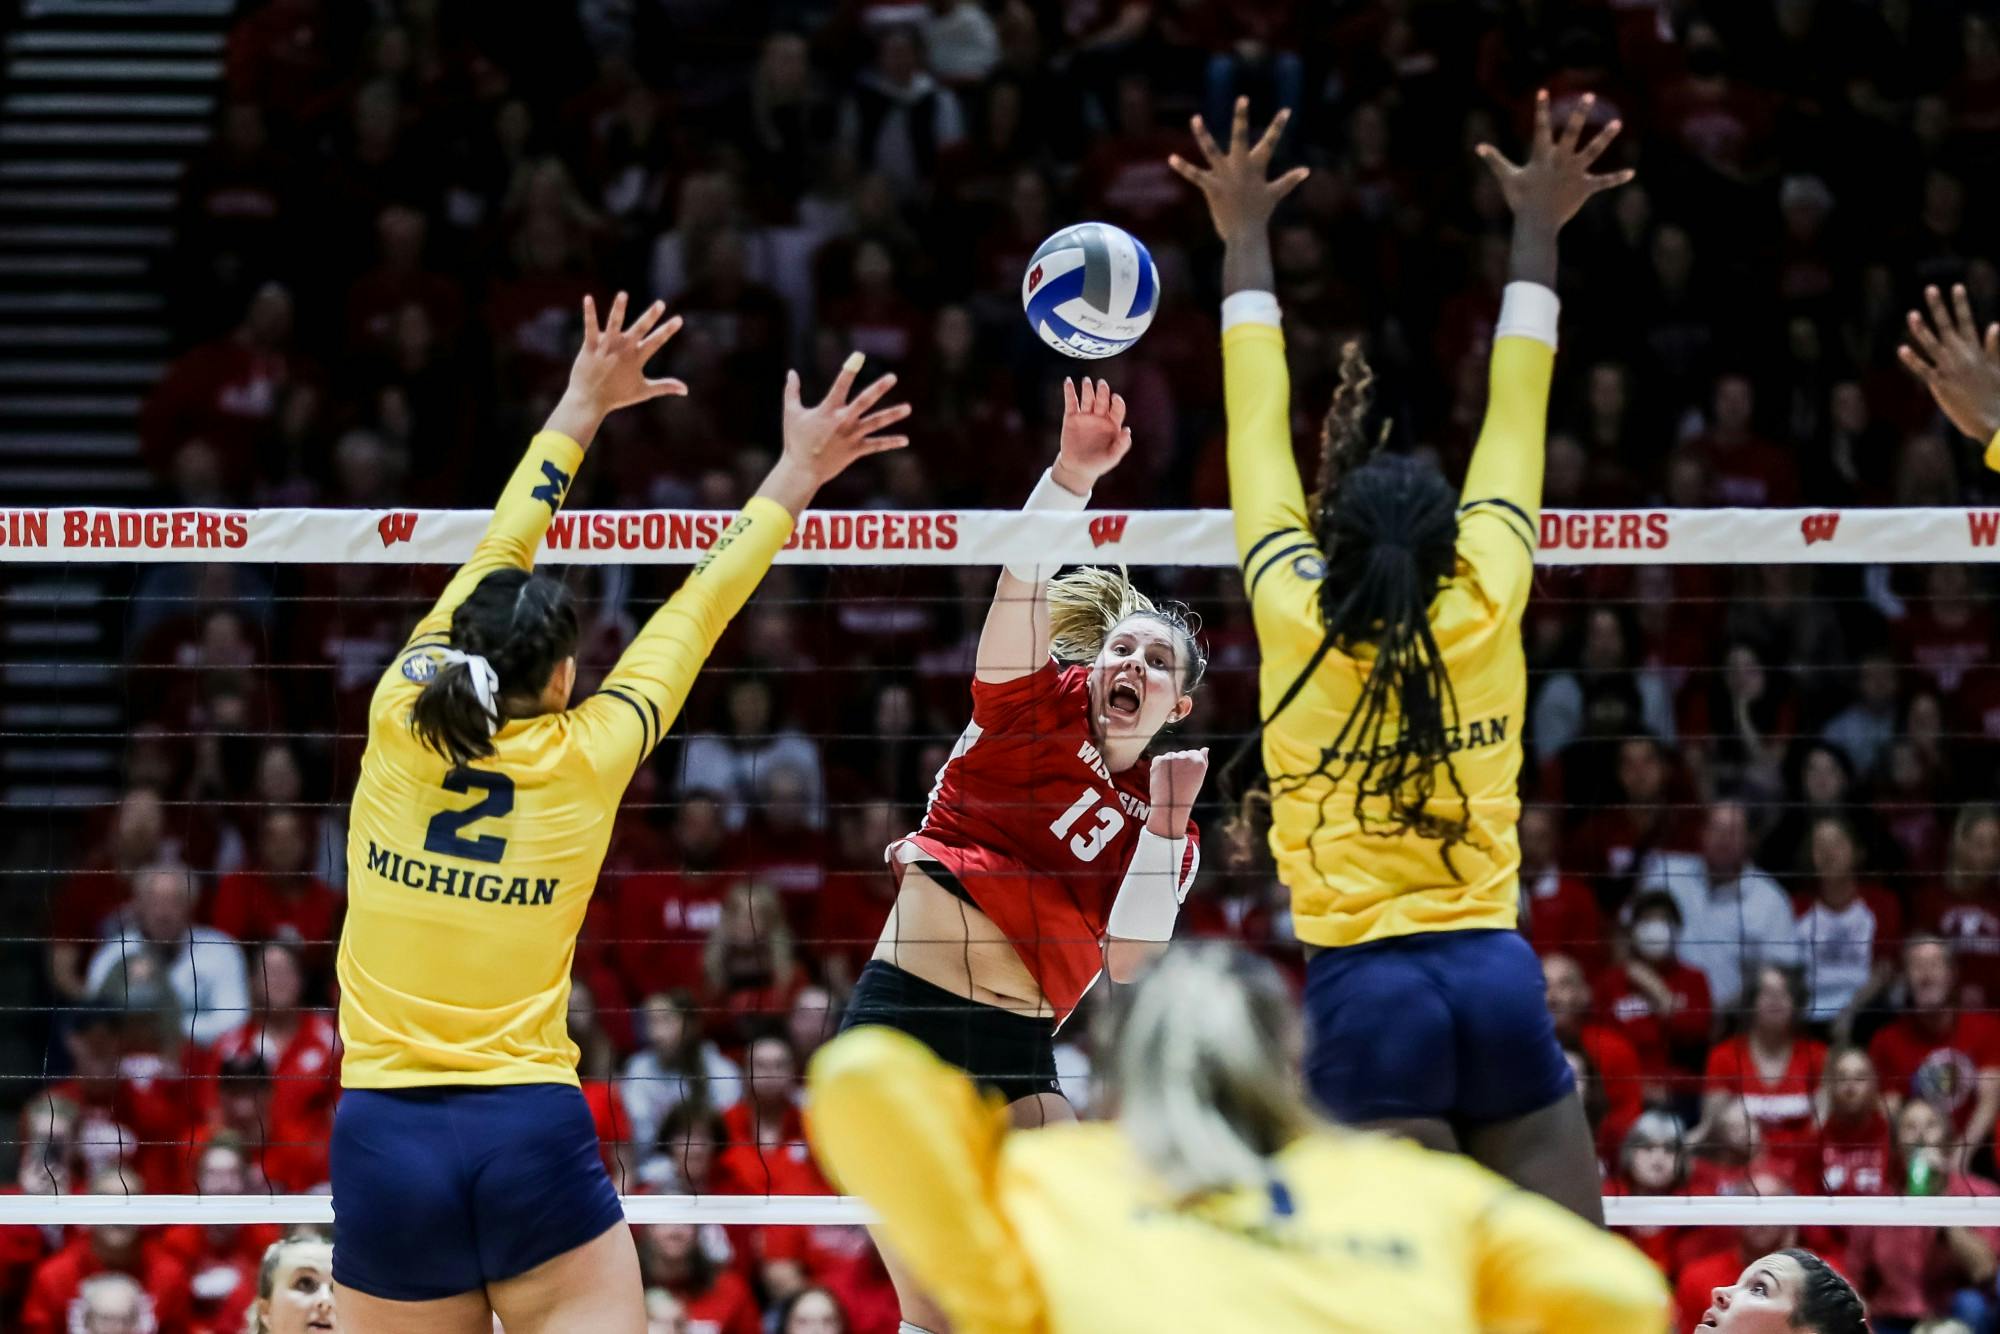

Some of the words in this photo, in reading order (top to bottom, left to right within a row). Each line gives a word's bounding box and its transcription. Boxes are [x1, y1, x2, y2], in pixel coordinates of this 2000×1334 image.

[531, 460, 571, 517] M
[63, 510, 248, 549] BADGERS
[378, 512, 419, 549] W
[1088, 514, 1128, 549] W
[1801, 512, 1840, 546] W
[423, 767, 516, 865] 2
[1050, 786, 1126, 862] 13
[367, 840, 560, 906] MICHIGAN
